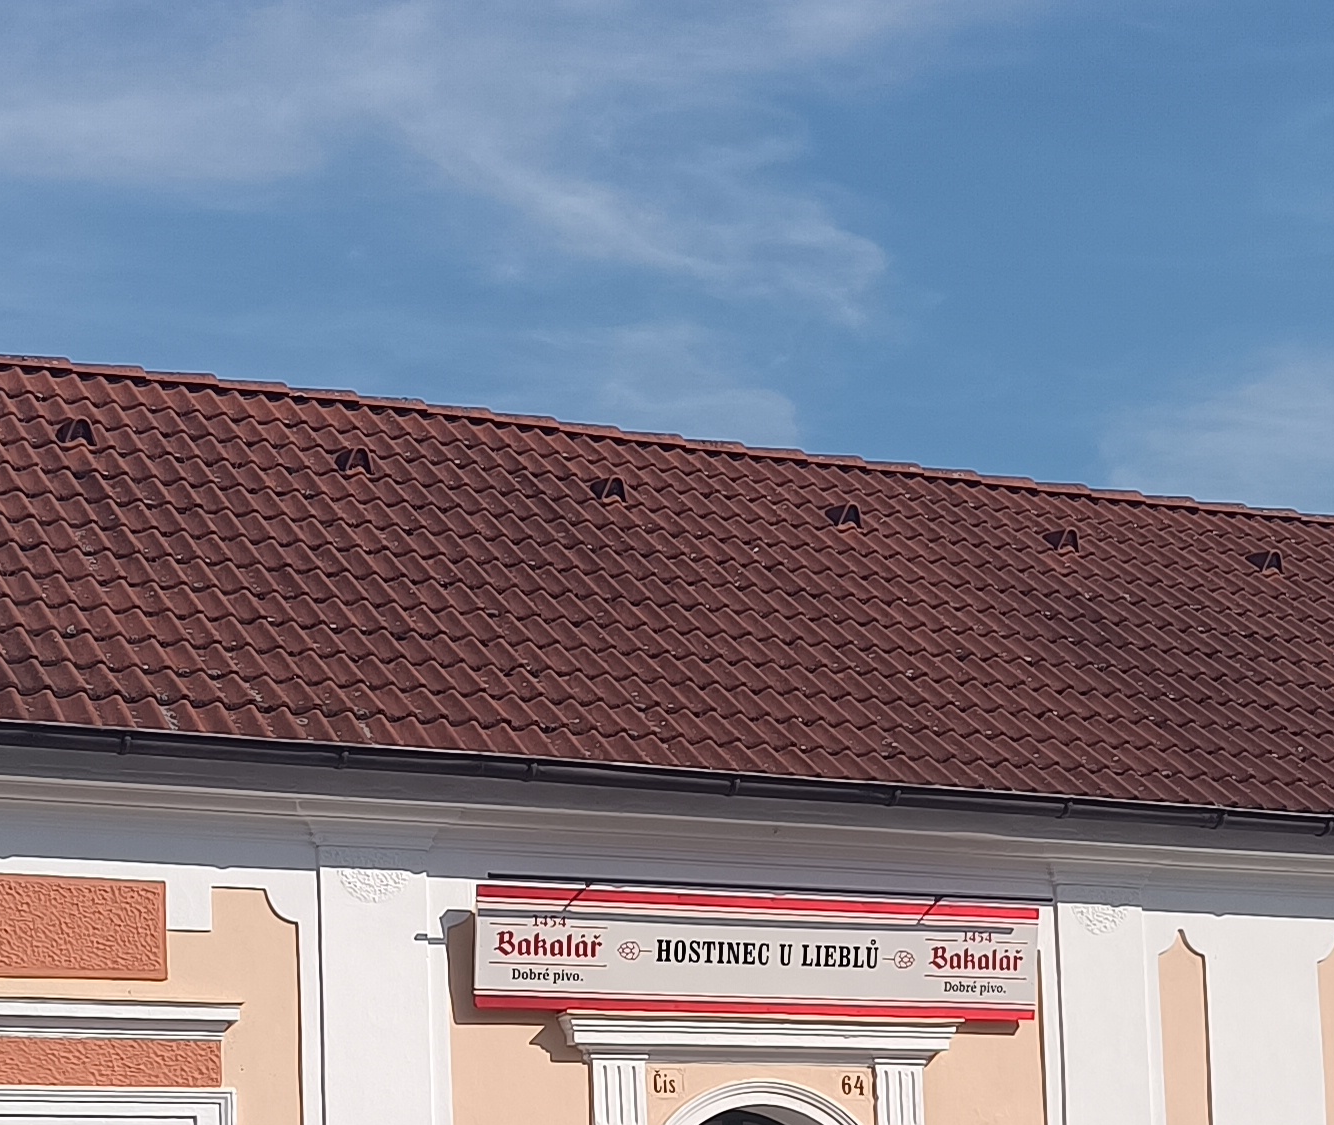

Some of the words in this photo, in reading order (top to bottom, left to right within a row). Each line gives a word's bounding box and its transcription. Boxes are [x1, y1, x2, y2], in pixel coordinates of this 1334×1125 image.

[532, 914, 566, 928] 1454
[494, 930, 602, 958] Bakalář
[962, 931, 992, 943] 1454
[656, 939, 770, 965] HOSTINEC
[779, 943, 793, 966] U
[801, 939, 879, 968] LIEBLŮ
[929, 946, 1023, 971] Bakalář
[512, 968, 549, 981] Dobré
[553, 969, 584, 984] pivo.
[944, 981, 976, 993] Dobré
[980, 982, 1007, 996] pivo.
[653, 1070, 676, 1093] Čis
[841, 1075, 864, 1096] 64
